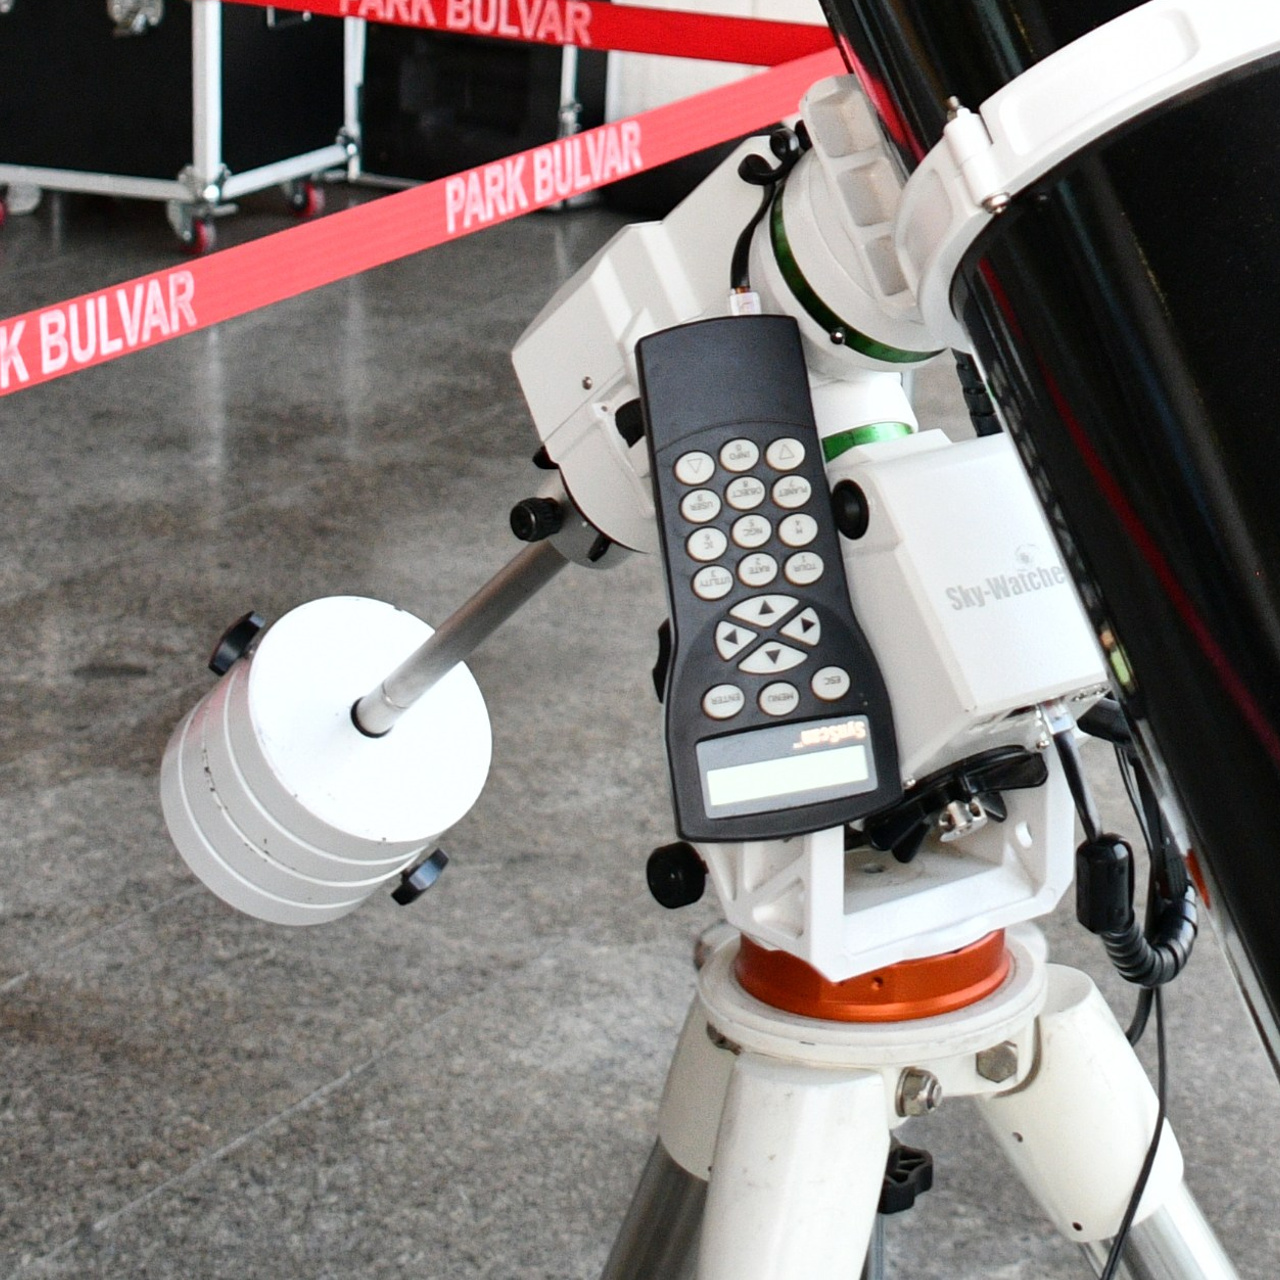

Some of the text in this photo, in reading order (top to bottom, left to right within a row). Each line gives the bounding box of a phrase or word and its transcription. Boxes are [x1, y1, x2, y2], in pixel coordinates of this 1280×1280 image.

[445, 120, 643, 233] PARK BULVAR
[39, 269, 198, 375] BULVAR
[731, 487, 762, 498] OBJECT
[778, 486, 808, 497] PLANET
[690, 501, 713, 511] USER
[743, 526, 763, 536] NGC
[749, 565, 770, 575] RATE
[794, 562, 817, 572] TOUR
[699, 576, 731, 587] UTILITY
[823, 676, 841, 685] ESC
[711, 693, 741, 705] ENTER
[767, 692, 794, 702] MENU
